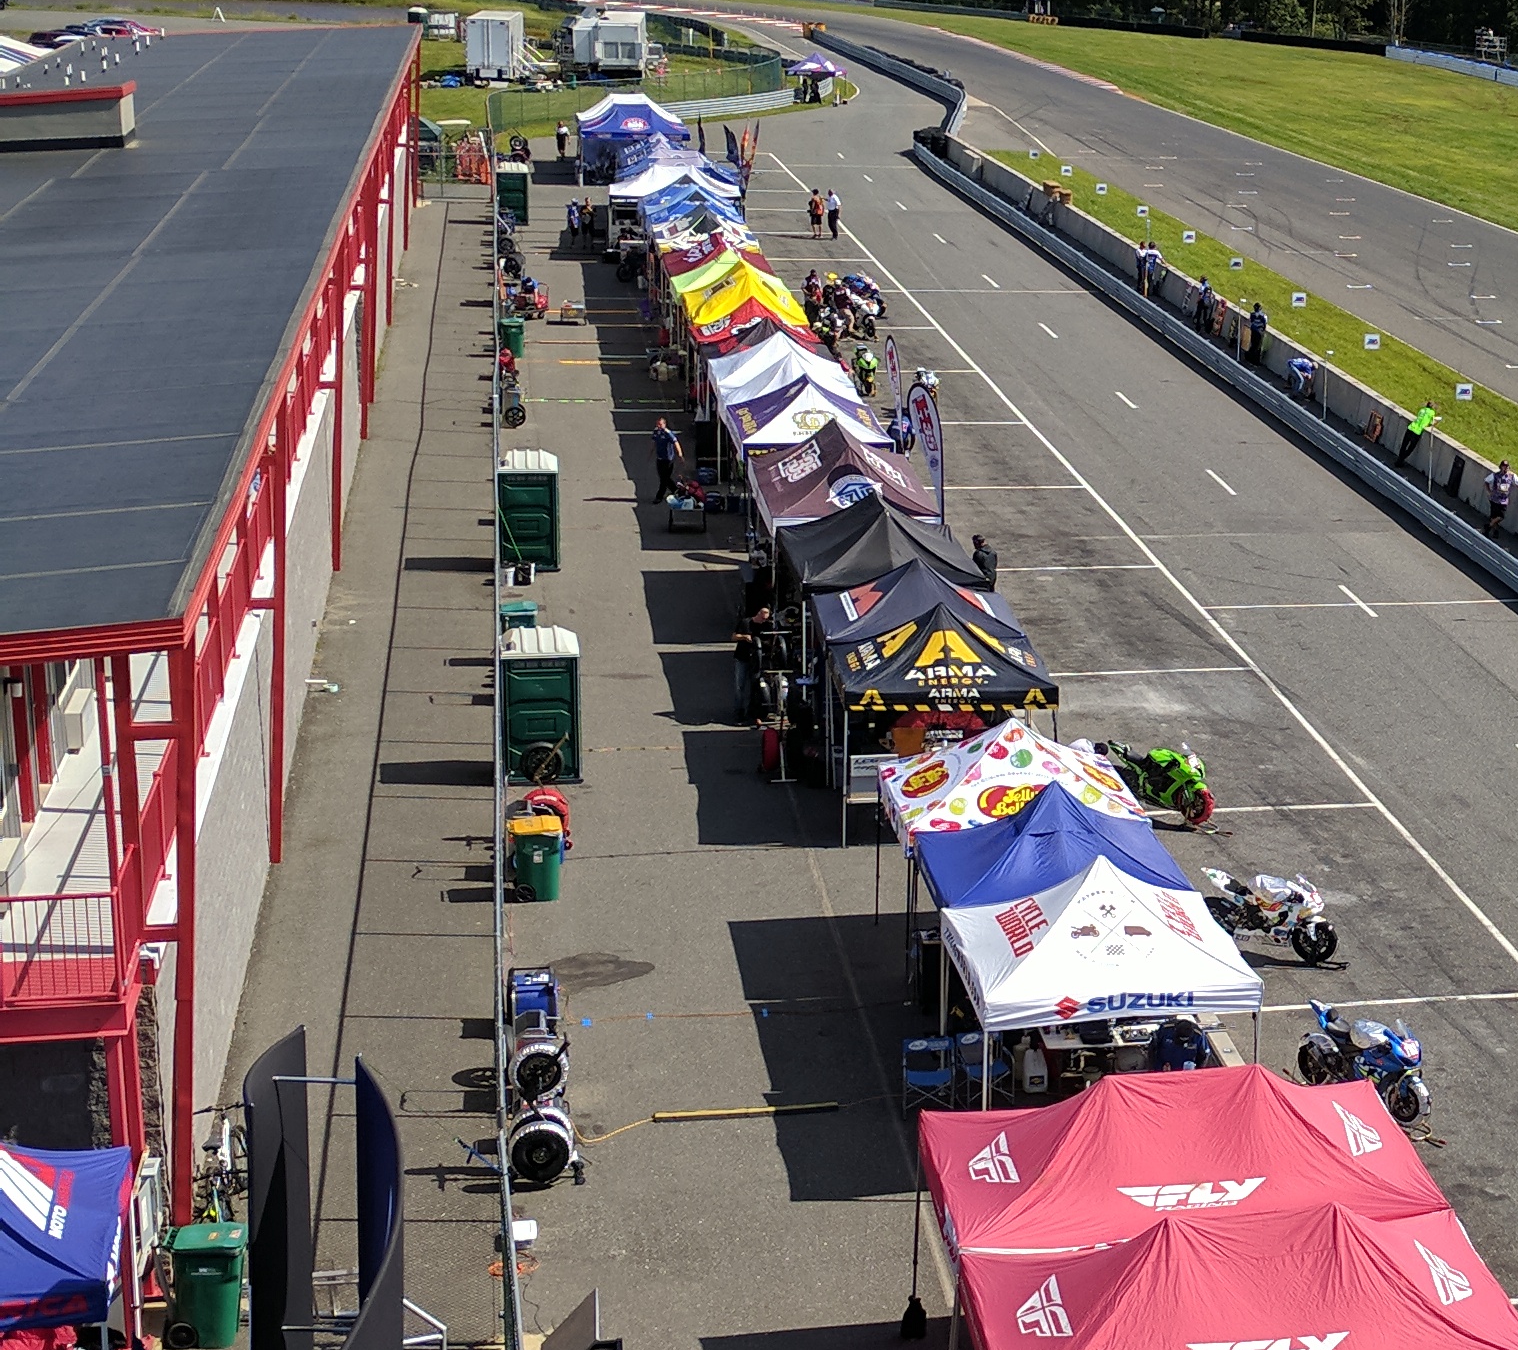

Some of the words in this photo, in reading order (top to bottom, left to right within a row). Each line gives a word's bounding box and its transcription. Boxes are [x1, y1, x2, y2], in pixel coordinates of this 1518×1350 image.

[904, 665, 997, 680] ARMA
[918, 678, 988, 687] ENERGY
[928, 688, 981, 699] ARMA
[1014, 897, 1049, 936] CYCLE
[995, 907, 1035, 958] WORLD
[1087, 991, 1195, 1013] SUZUKI
[1117, 1177, 1267, 1207] FLY
